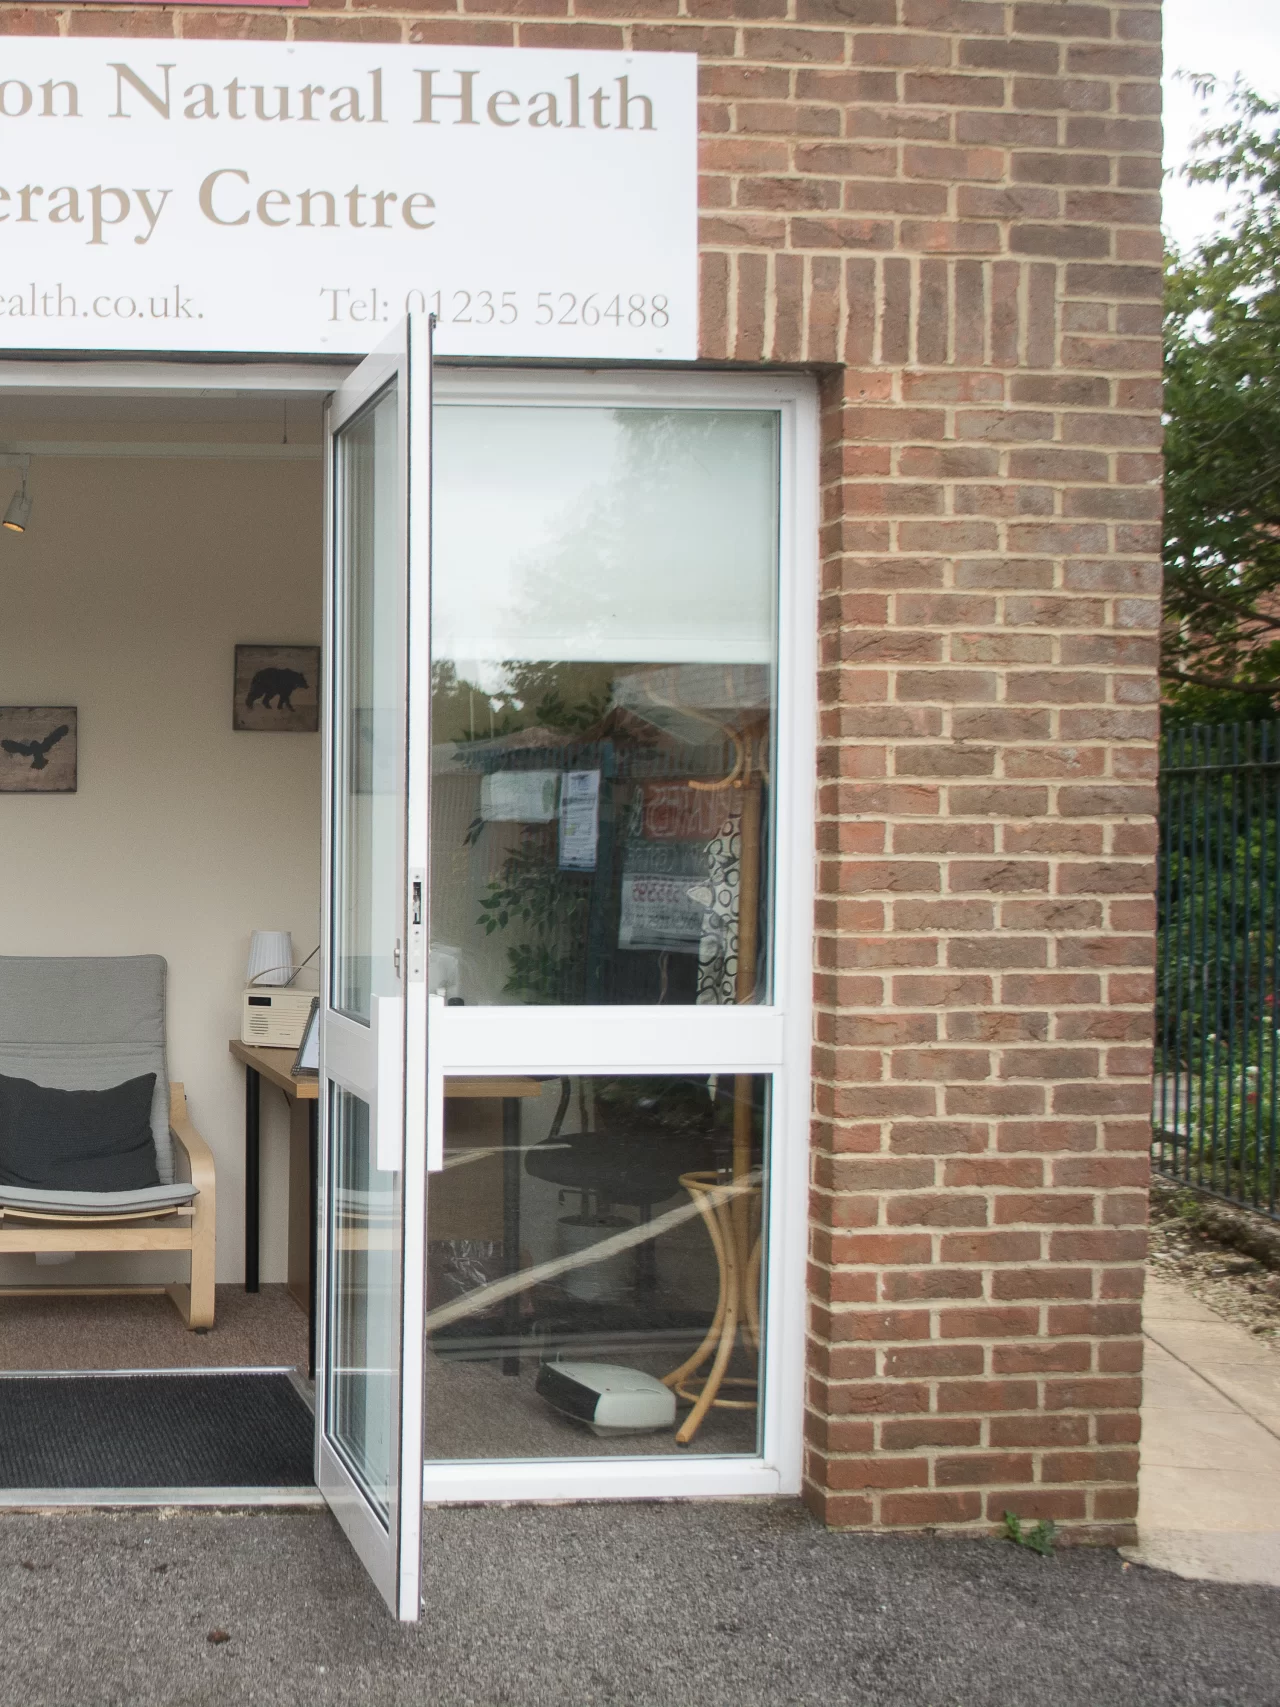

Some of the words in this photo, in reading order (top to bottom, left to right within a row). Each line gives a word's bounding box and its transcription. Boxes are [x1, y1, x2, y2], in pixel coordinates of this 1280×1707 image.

[106, 62, 389, 124] Natural
[412, 68, 657, 131] Health
[198, 168, 436, 231] Centre
[319, 286, 389, 324] Tel:
[405, 288, 519, 326] 01235
[535, 290, 671, 330] 526488
